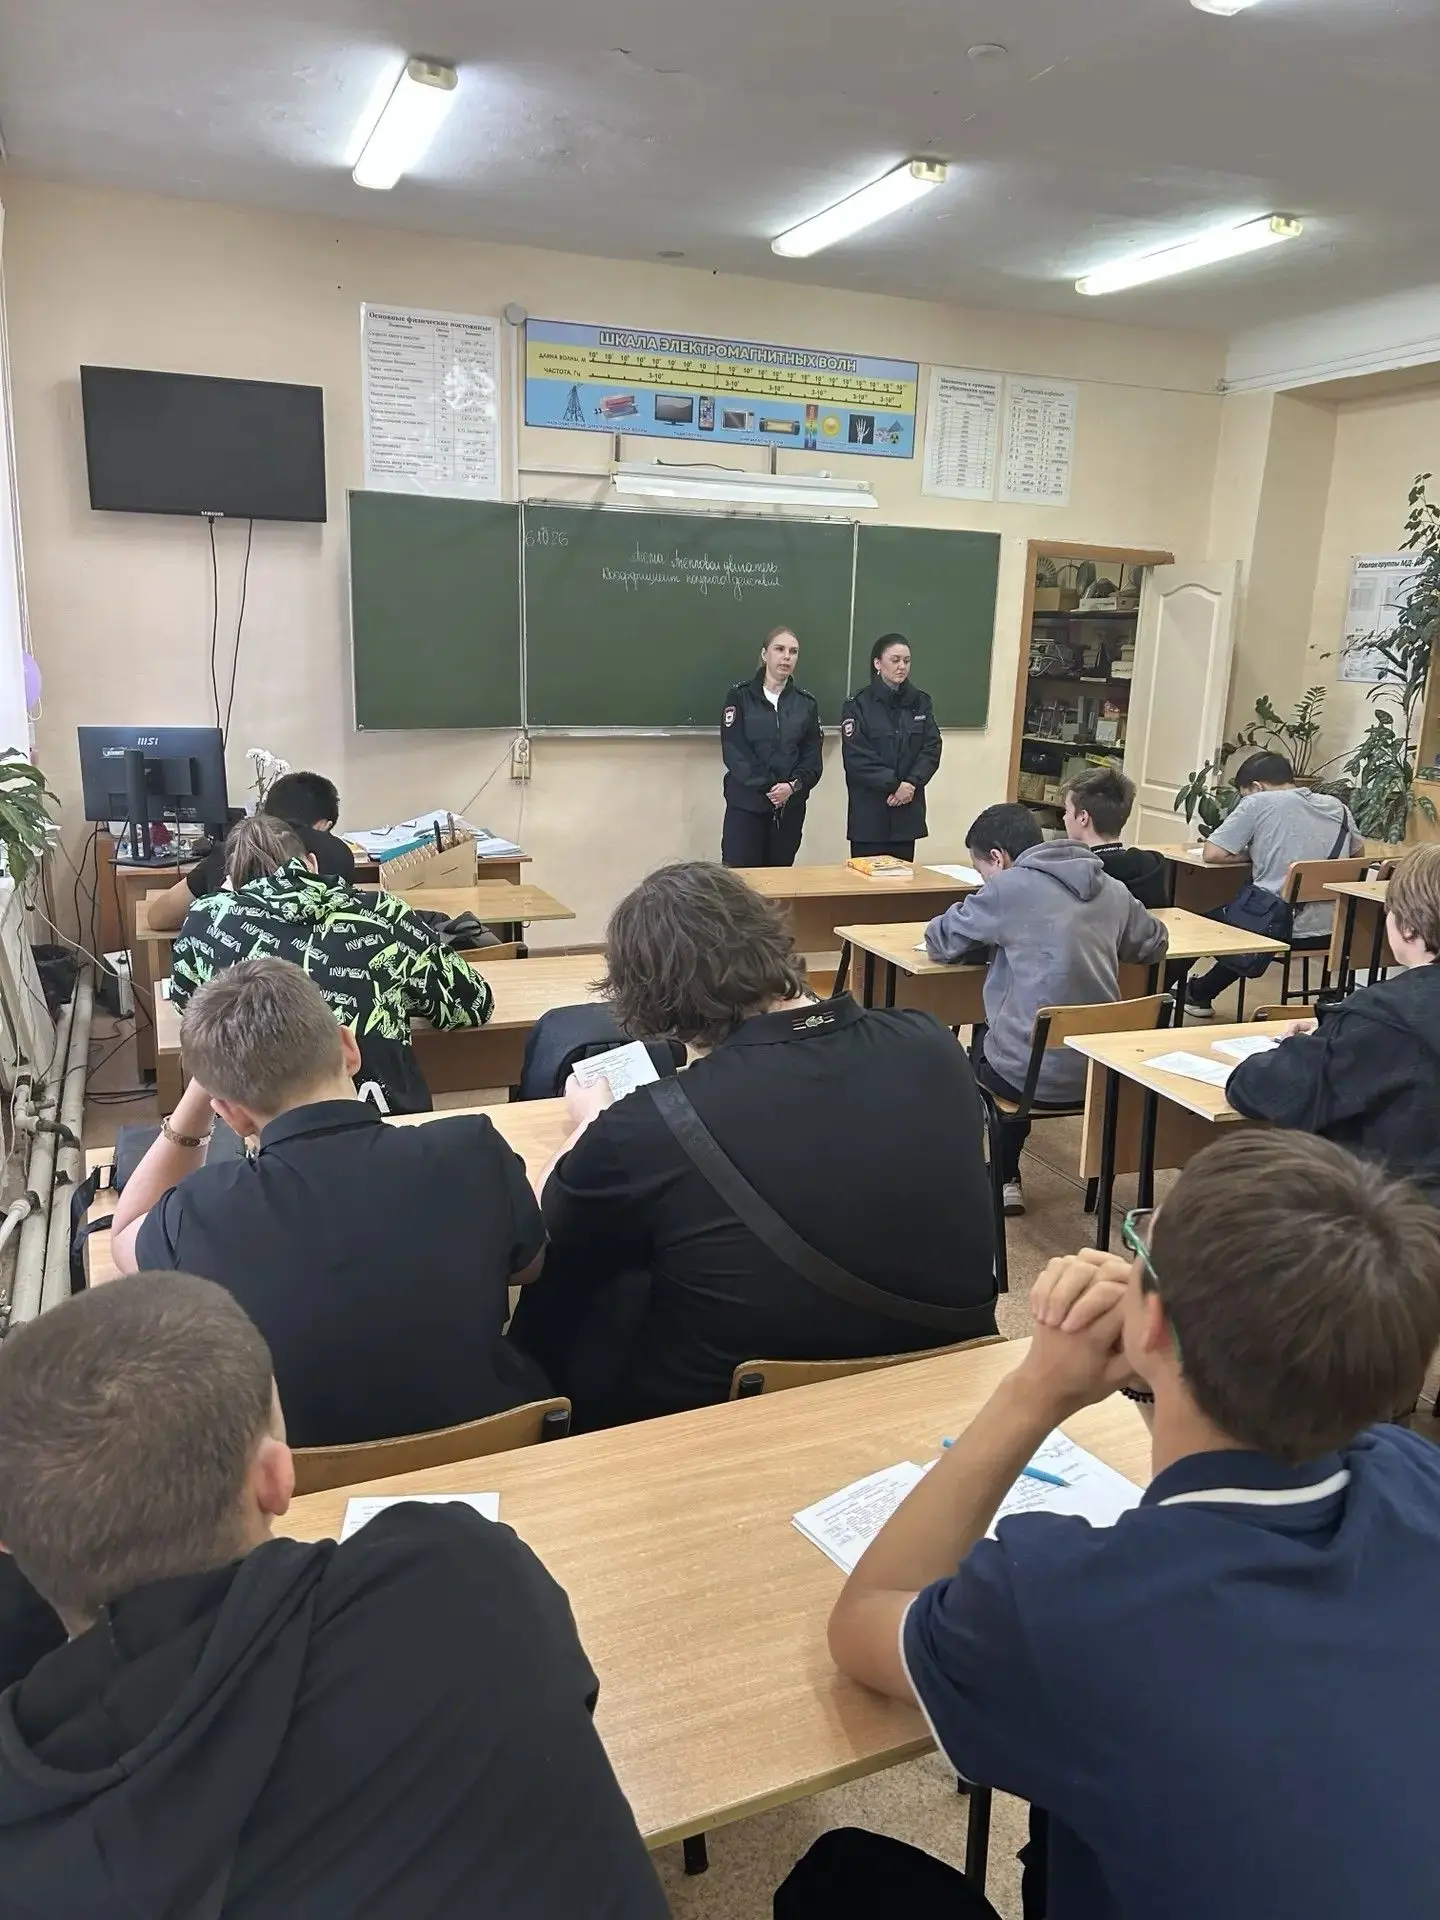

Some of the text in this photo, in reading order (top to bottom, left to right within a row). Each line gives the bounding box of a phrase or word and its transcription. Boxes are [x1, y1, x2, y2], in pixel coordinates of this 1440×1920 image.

[369, 311, 405, 322] Основные
[406, 316, 449, 328] физические
[600, 331, 857, 373] ШКАЛА ЭЛЕКТРОМАГНИТНЫХ ВОЛН
[345, 933, 385, 952] NASA
[330, 966, 371, 981] NASA
